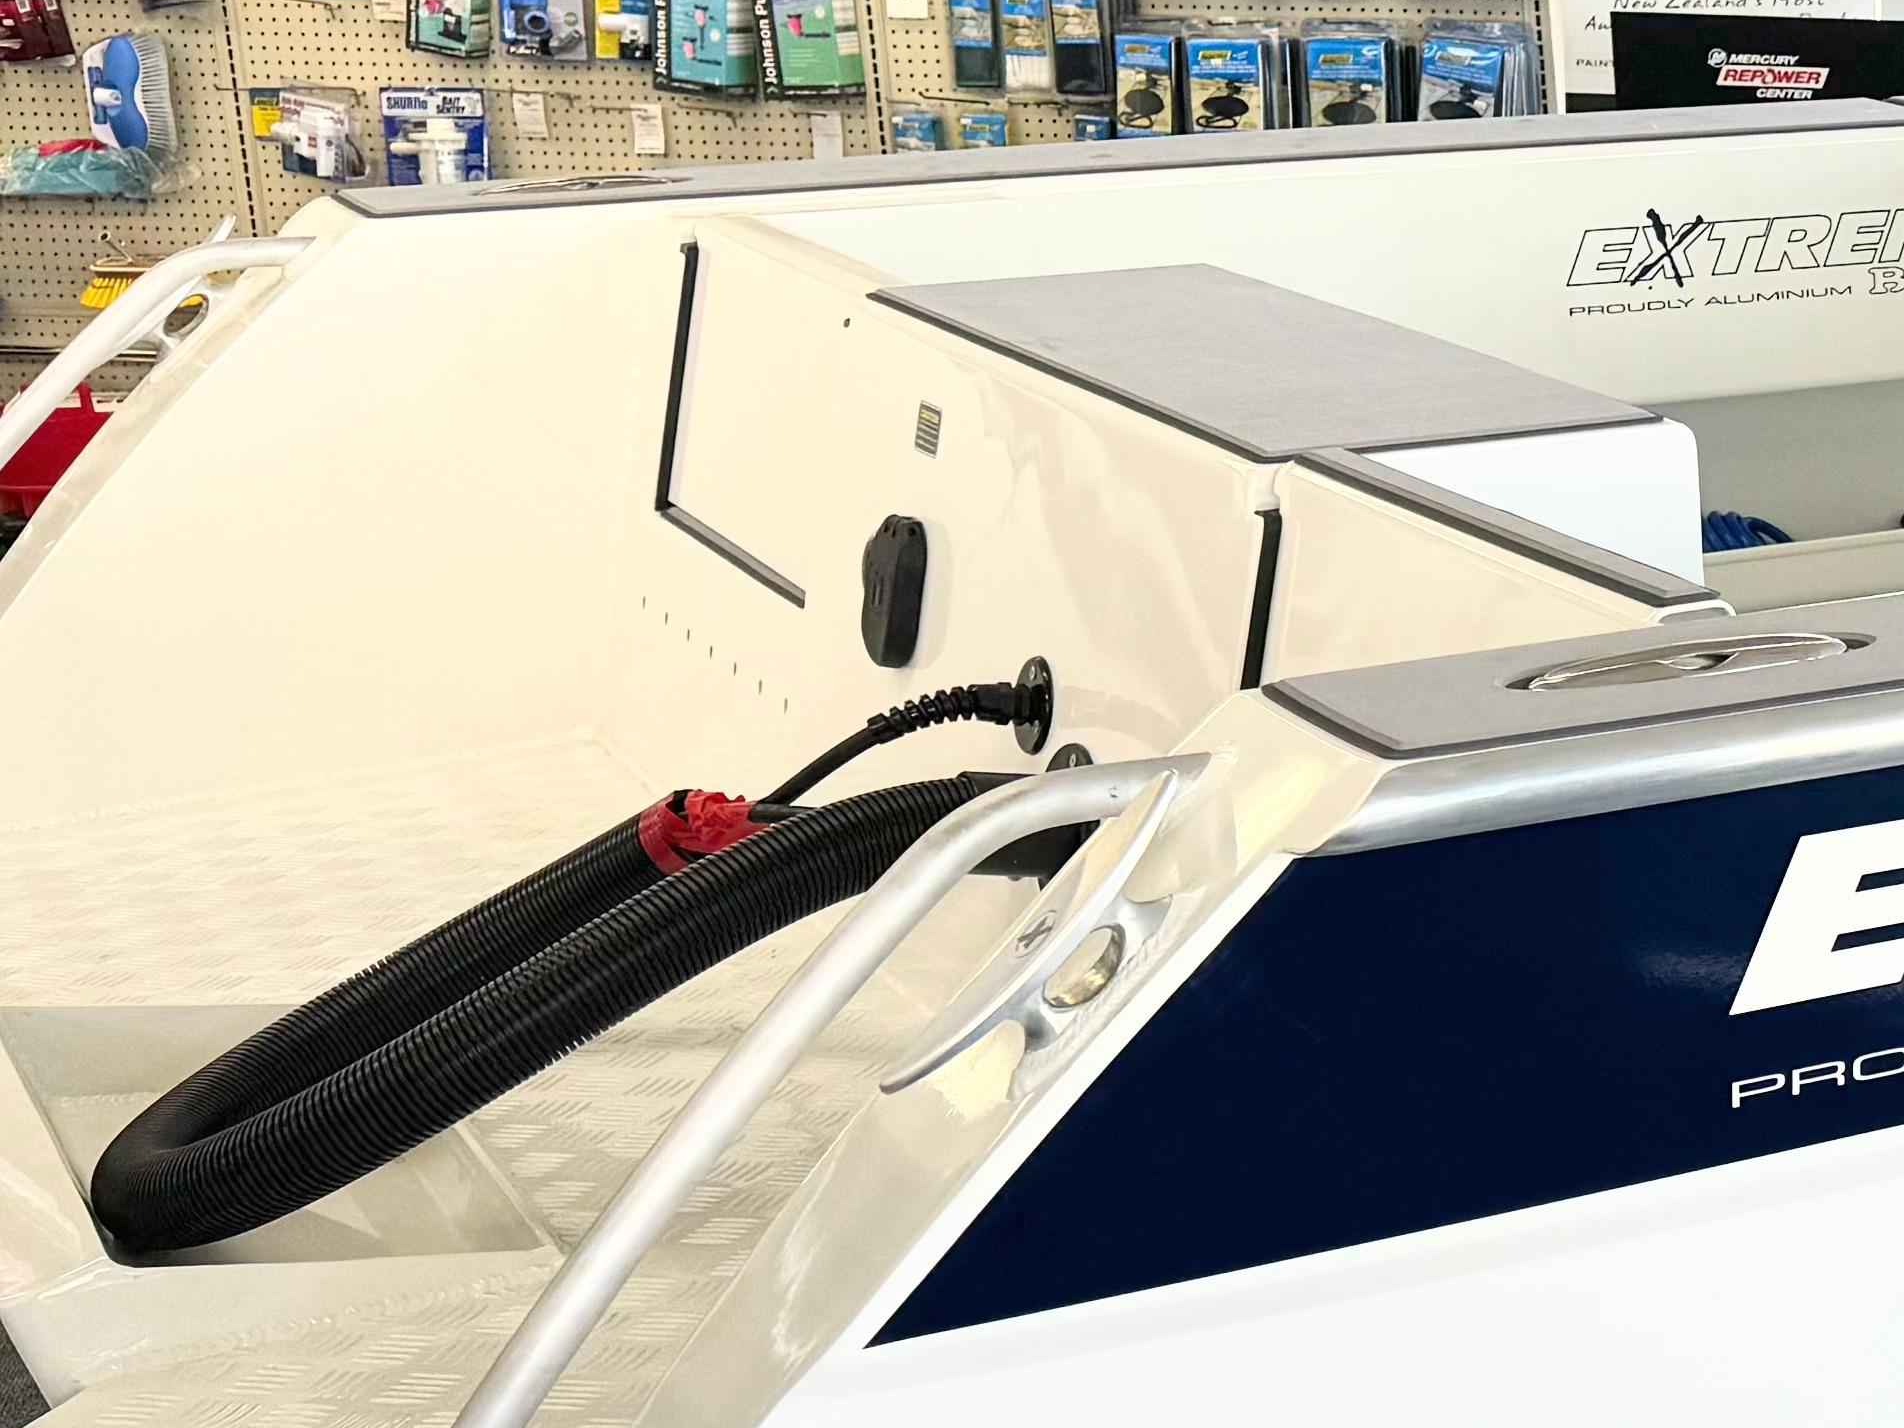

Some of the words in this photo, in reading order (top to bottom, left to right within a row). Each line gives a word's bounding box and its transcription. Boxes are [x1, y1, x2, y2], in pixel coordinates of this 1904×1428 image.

[655, 8, 668, 76] Johnson
[760, 19, 778, 85] Johnson
[1728, 53, 1800, 66] MERCURY
[1722, 68, 1822, 86] REPOWER
[1756, 88, 1814, 100] CENTER
[1569, 298, 1695, 317] PROUDLY
[1704, 284, 1853, 307] ALUMINIUM
